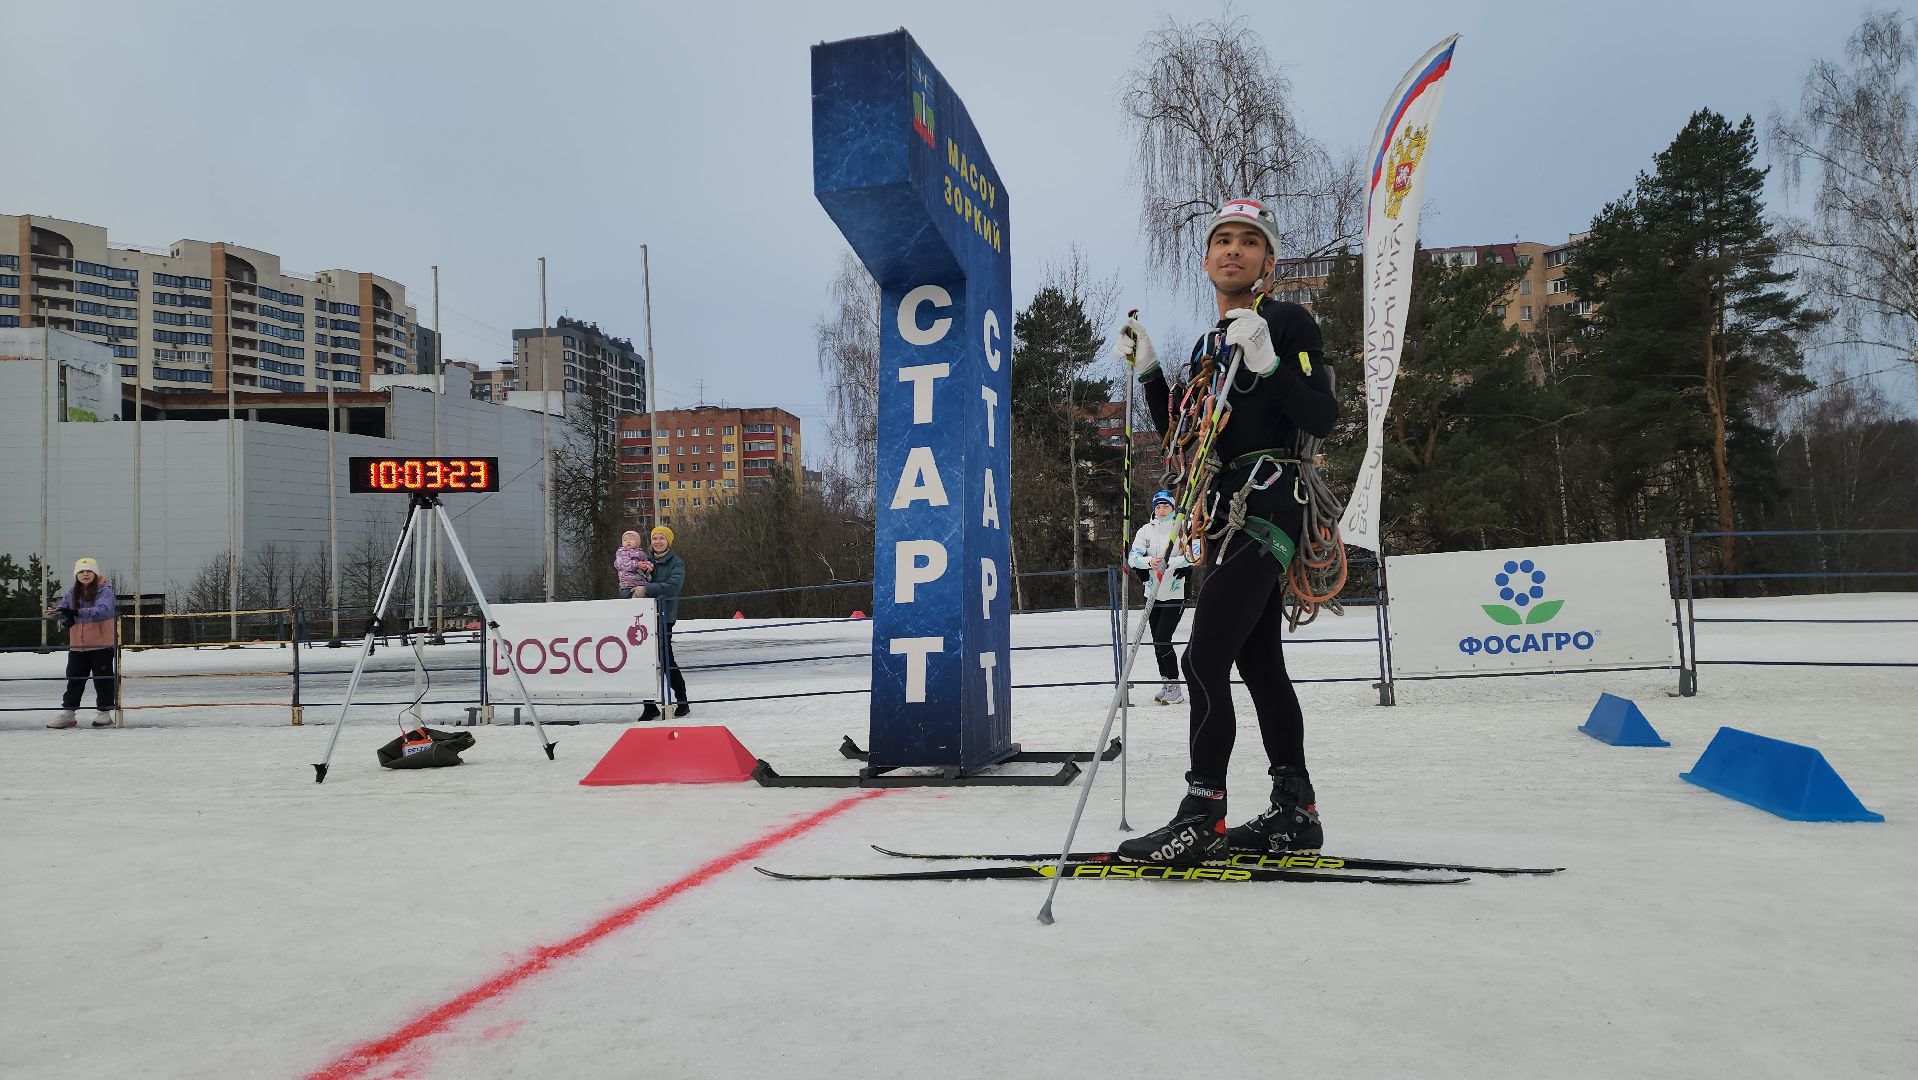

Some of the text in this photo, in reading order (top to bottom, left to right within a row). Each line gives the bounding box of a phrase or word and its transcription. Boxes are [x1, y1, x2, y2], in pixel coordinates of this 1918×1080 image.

[947, 137, 996, 209] МАСОУ
[944, 175, 1001, 254] ЗОРКИЙ
[369, 460, 489, 489] 10:03:23
[890, 284, 953, 703] СТАРТ
[979, 309, 1001, 716] СТАРТ
[492, 635, 628, 676] BOSCO
[1458, 630, 1595, 656] ФОСАГРО
[1072, 865, 1252, 881] FISCHER
